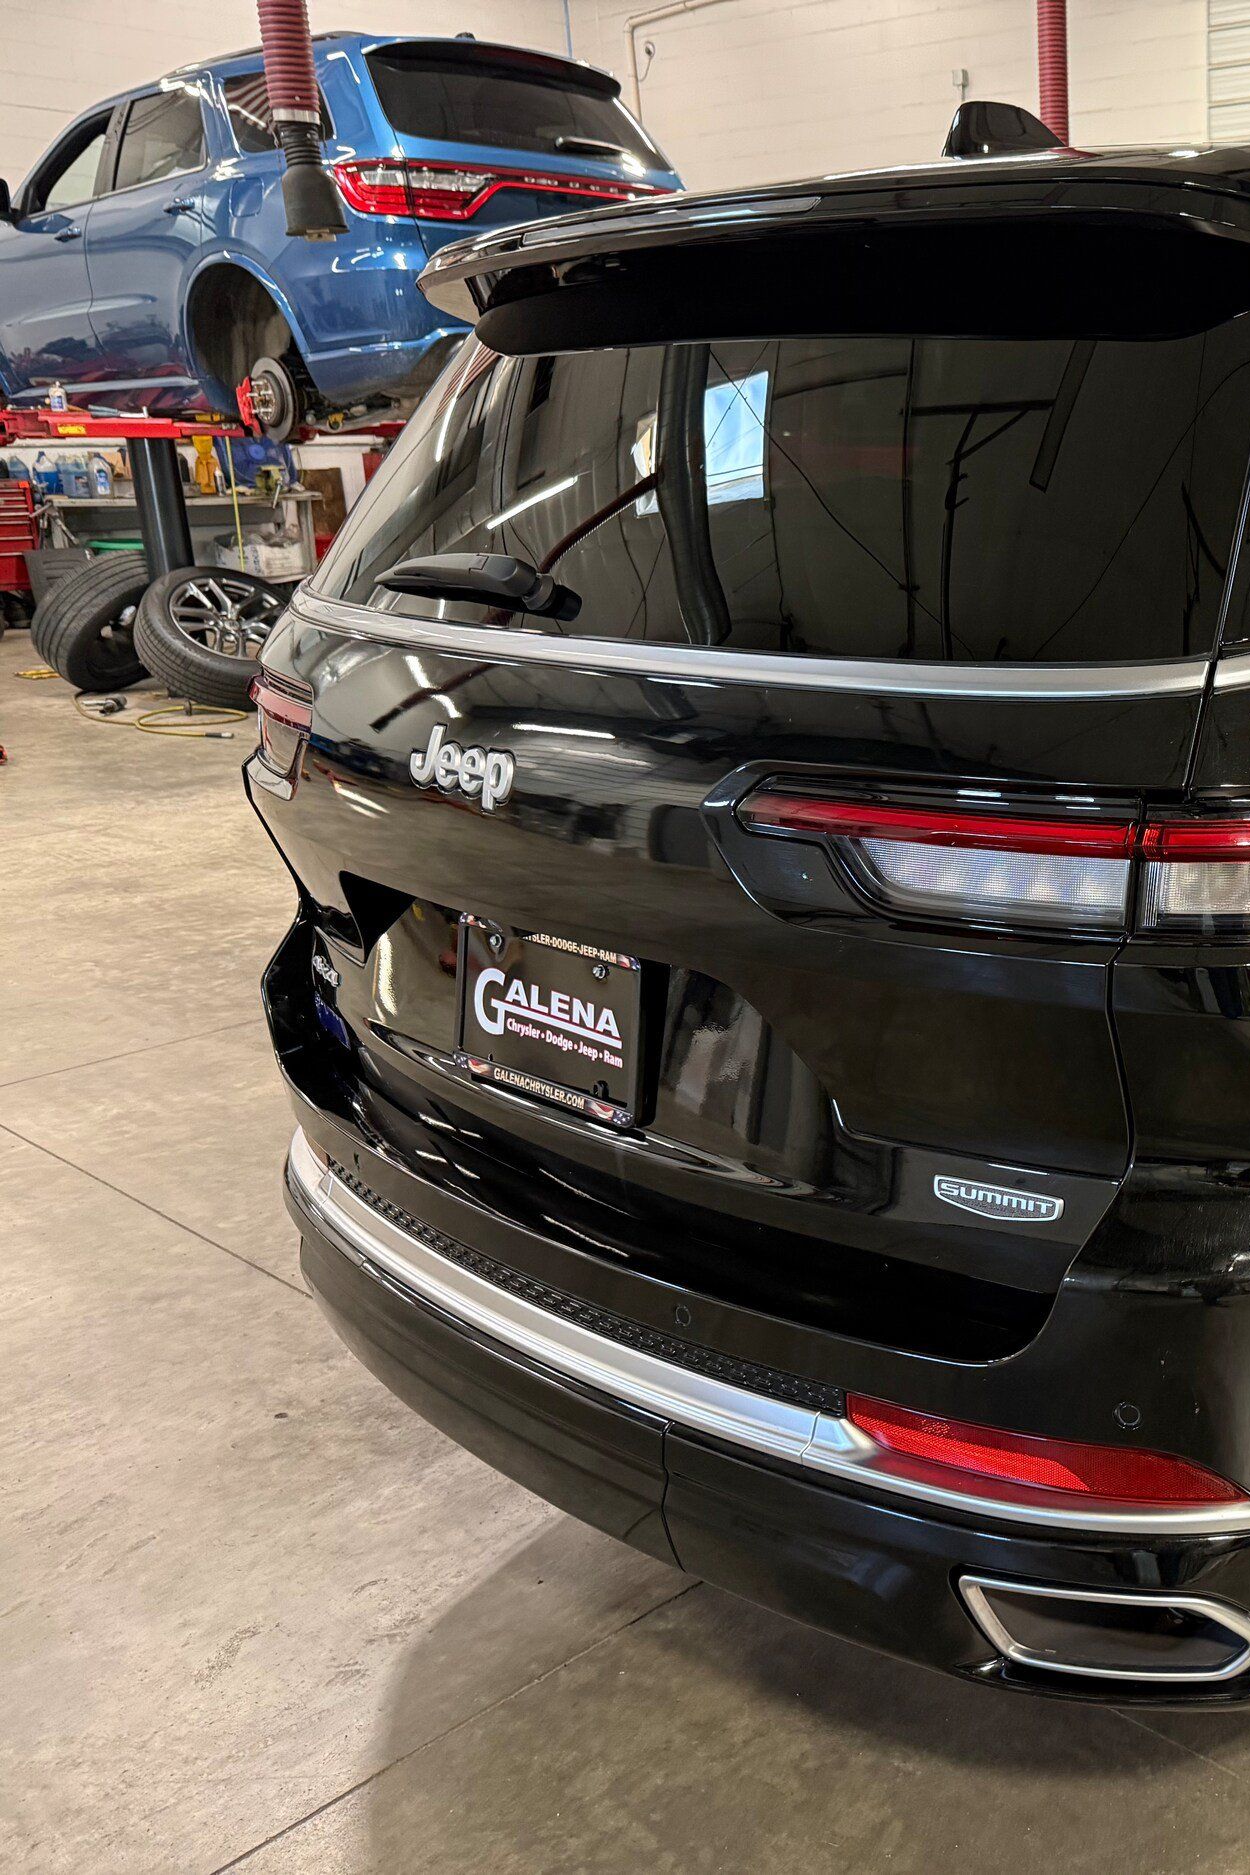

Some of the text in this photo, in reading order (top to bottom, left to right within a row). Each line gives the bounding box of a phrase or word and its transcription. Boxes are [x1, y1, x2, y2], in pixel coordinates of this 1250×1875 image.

[410, 724, 514, 810] Jeep
[474, 967, 621, 1038] GALENA
[506, 1018, 623, 1069] Chrysler Dodge Jeep Ram
[493, 1067, 585, 1110] GALENACHRYSLER.COM
[940, 1182, 1053, 1214] SUMMIT
